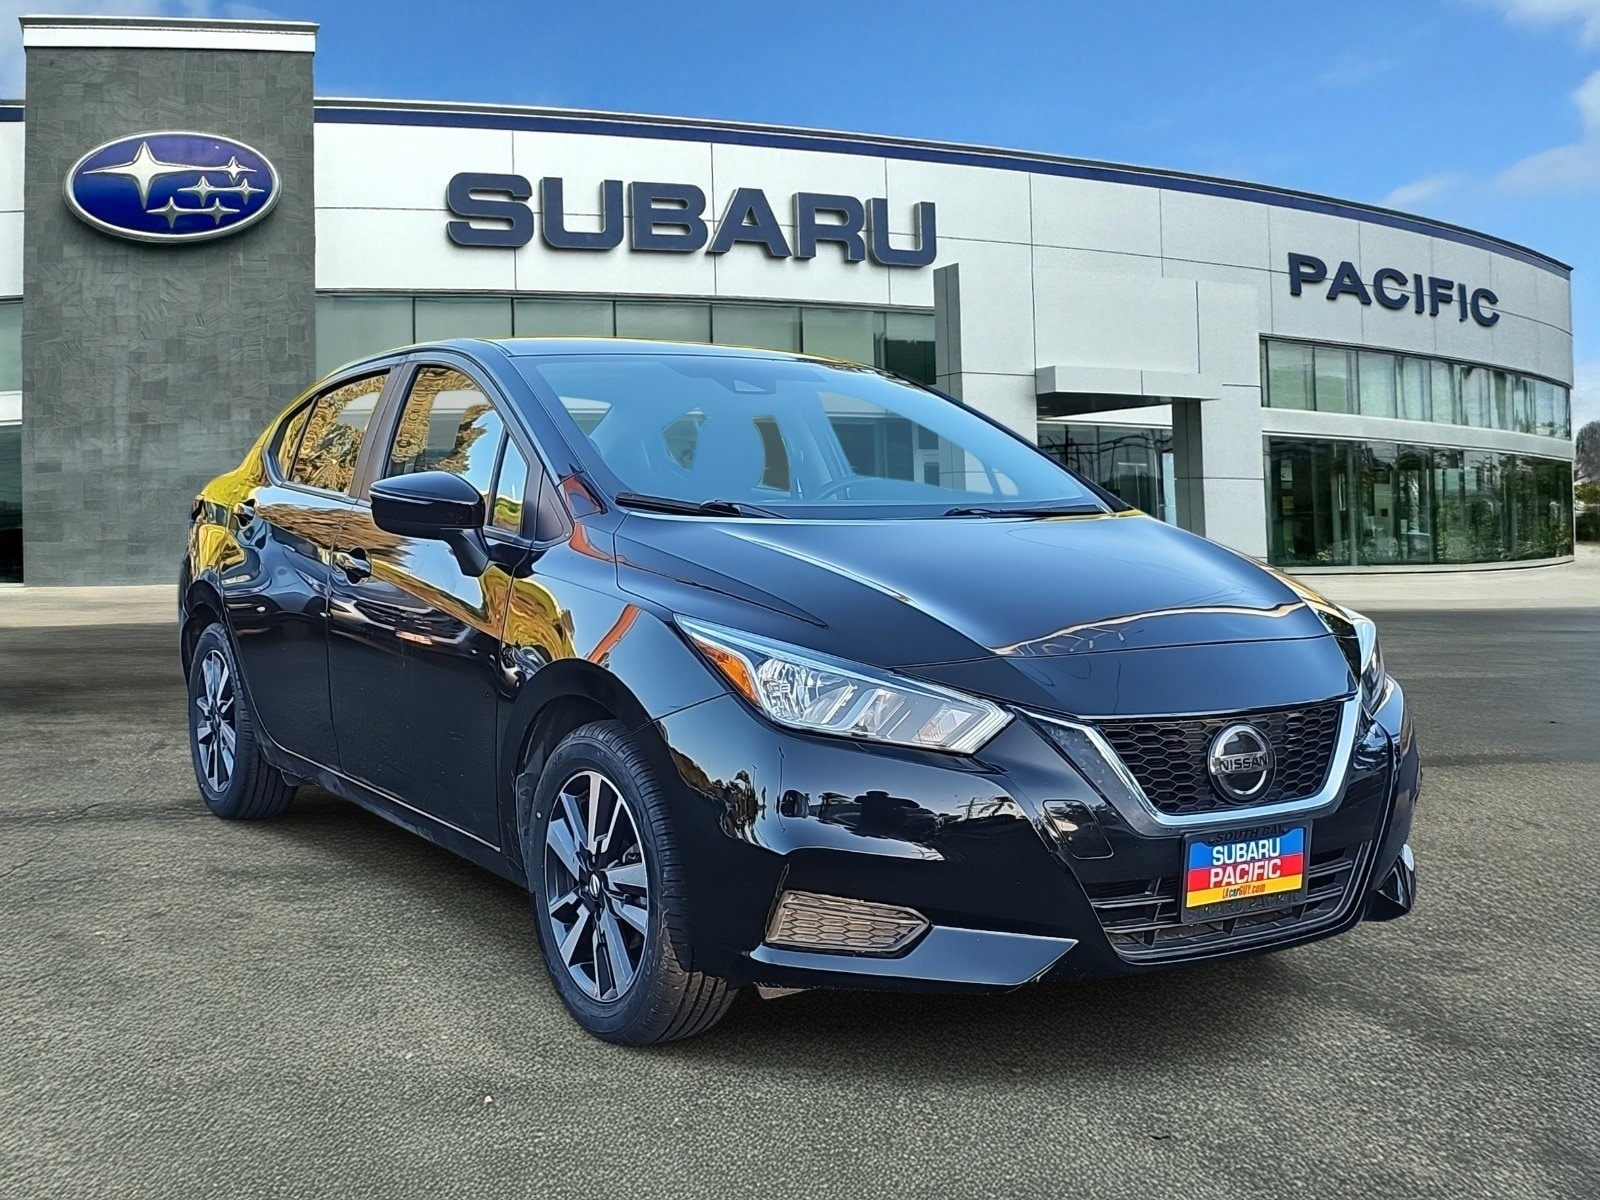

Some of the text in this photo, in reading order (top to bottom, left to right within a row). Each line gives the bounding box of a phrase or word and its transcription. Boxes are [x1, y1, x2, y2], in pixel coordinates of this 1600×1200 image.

[446, 172, 937, 268] SUBARU
[1288, 252, 1500, 327] PACIFIC
[1219, 755, 1268, 771] NISSAN
[1215, 828, 1259, 842] SOUTH
[1212, 837, 1281, 866] SUBARU
[1209, 858, 1282, 889] PACIFIC
